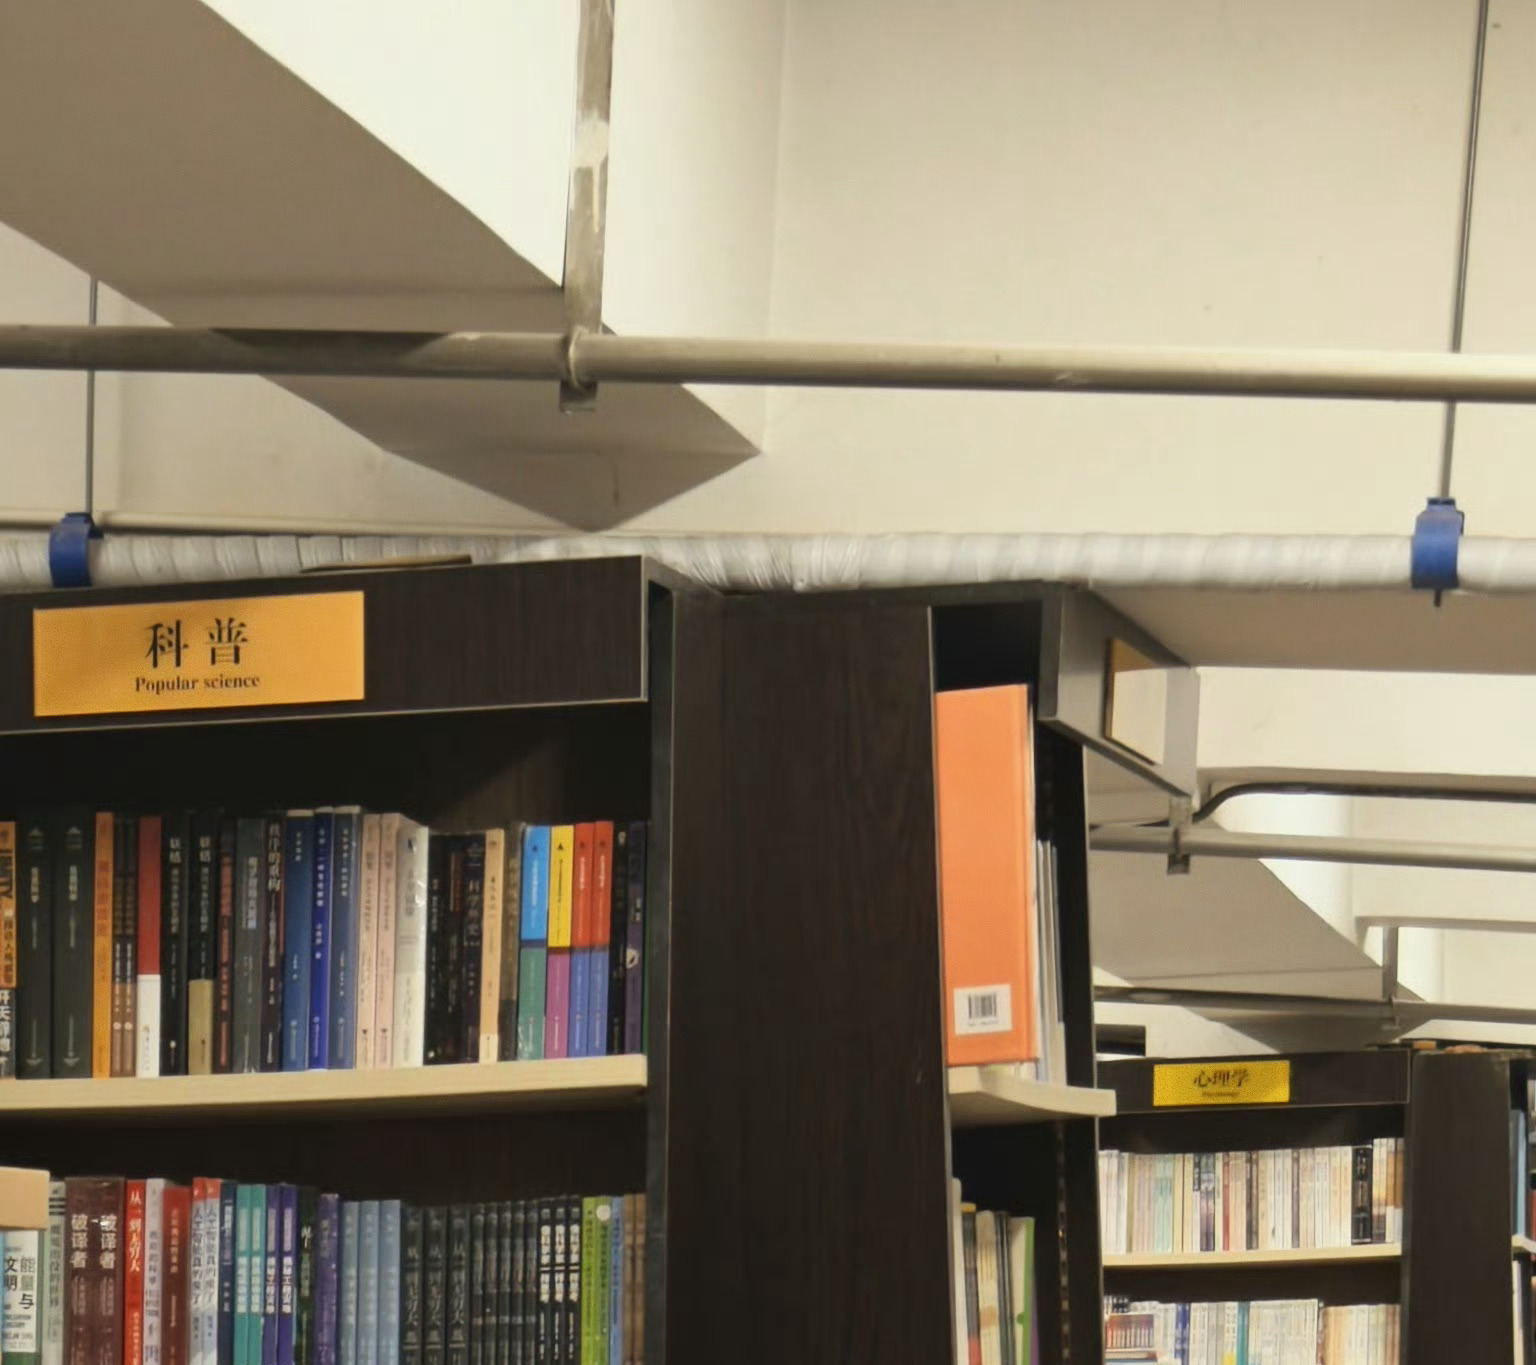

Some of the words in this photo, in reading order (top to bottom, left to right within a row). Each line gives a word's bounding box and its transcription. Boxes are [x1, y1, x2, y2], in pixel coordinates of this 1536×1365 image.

[145, 617, 249, 669] 科普
[135, 675, 199, 695] Popular
[203, 675, 261, 689] science
[1193, 1070, 1250, 1089] 心理学
